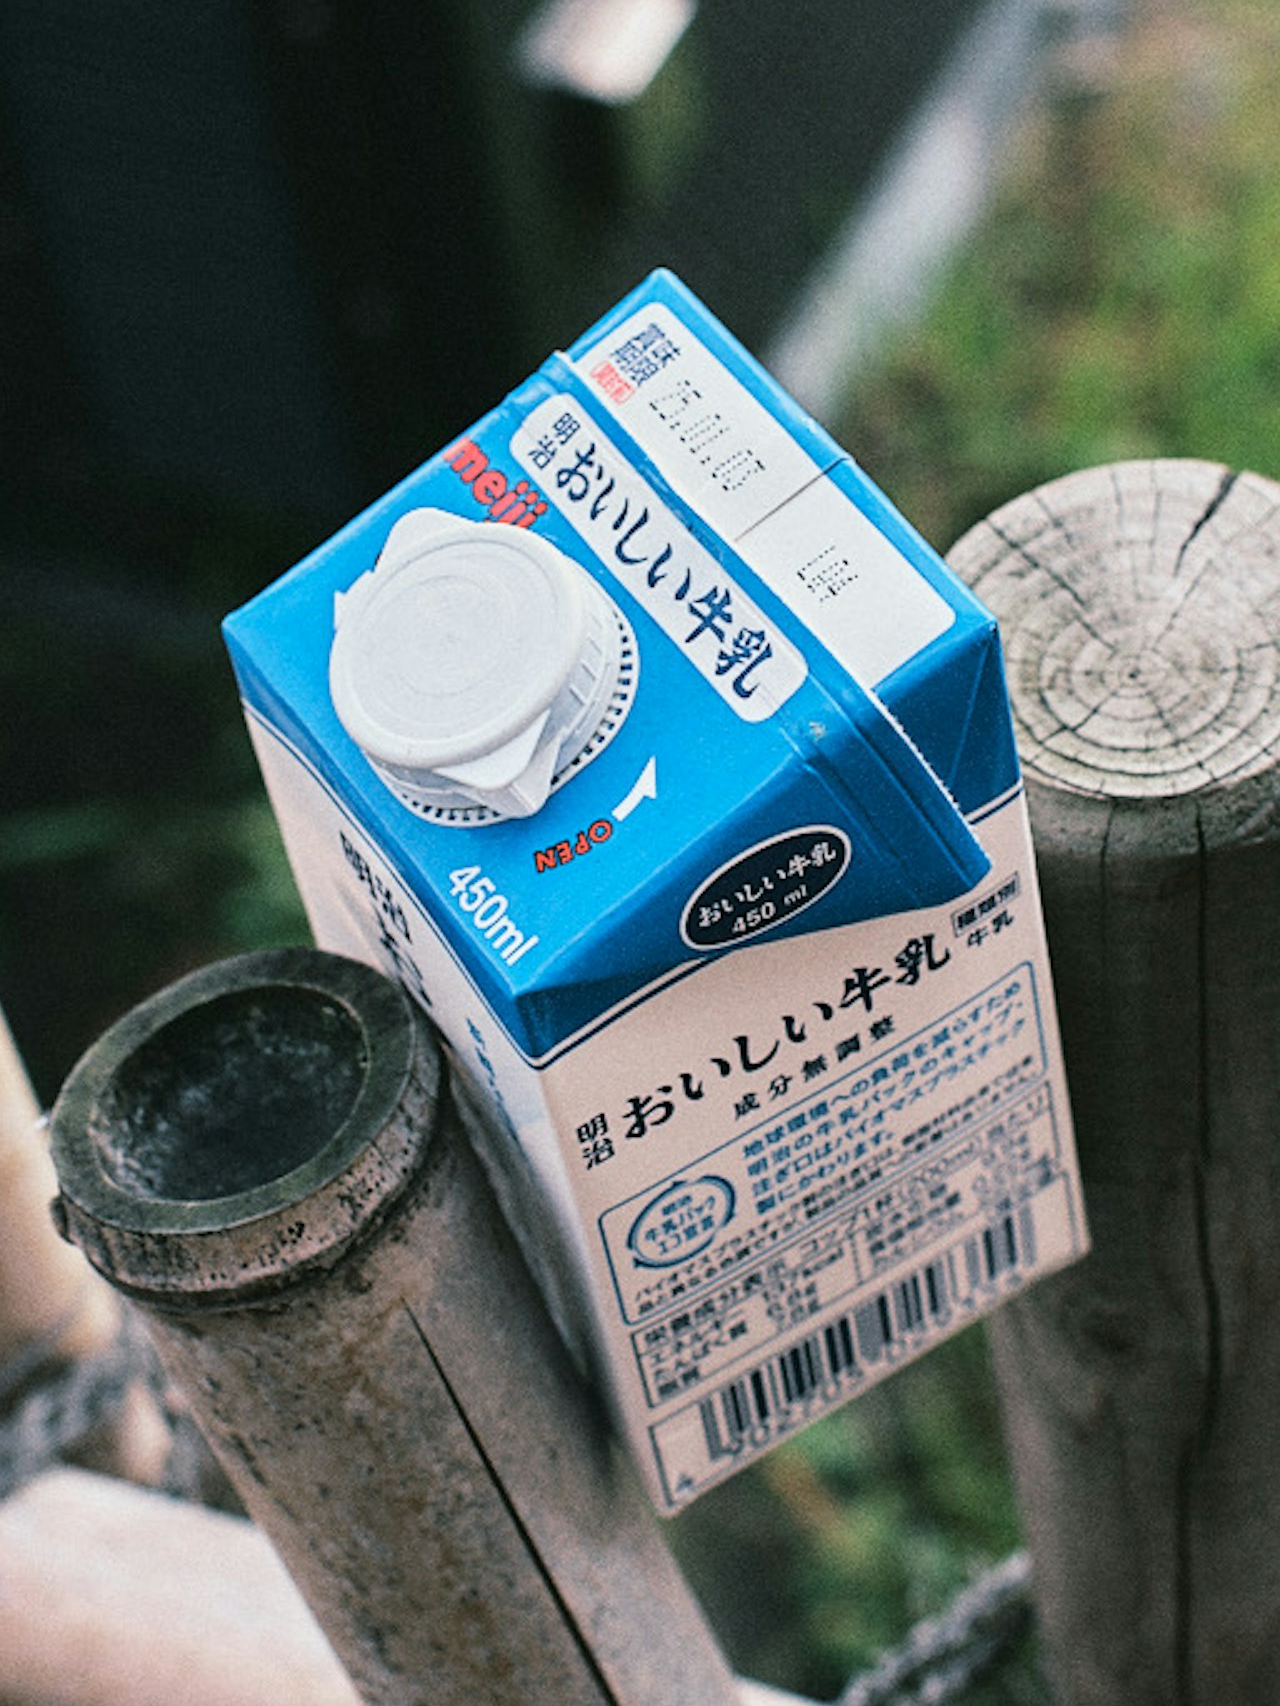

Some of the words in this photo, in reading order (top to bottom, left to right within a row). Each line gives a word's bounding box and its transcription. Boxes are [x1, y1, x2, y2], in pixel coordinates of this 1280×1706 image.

[444, 437, 548, 530] meiji
[527, 411, 581, 471] 明治
[556, 442, 772, 698] おいしい牛乳
[534, 819, 613, 874] OPEN
[697, 840, 836, 929] おいしい牛乳
[448, 865, 539, 968] 450ml
[732, 901, 776, 935] 450
[783, 884, 808, 908] ml
[965, 908, 1015, 950] 牛乳
[574, 1111, 616, 1170] 明治
[623, 933, 951, 1139] おいしい牛乳
[731, 1013, 896, 1120] 成分無調整
